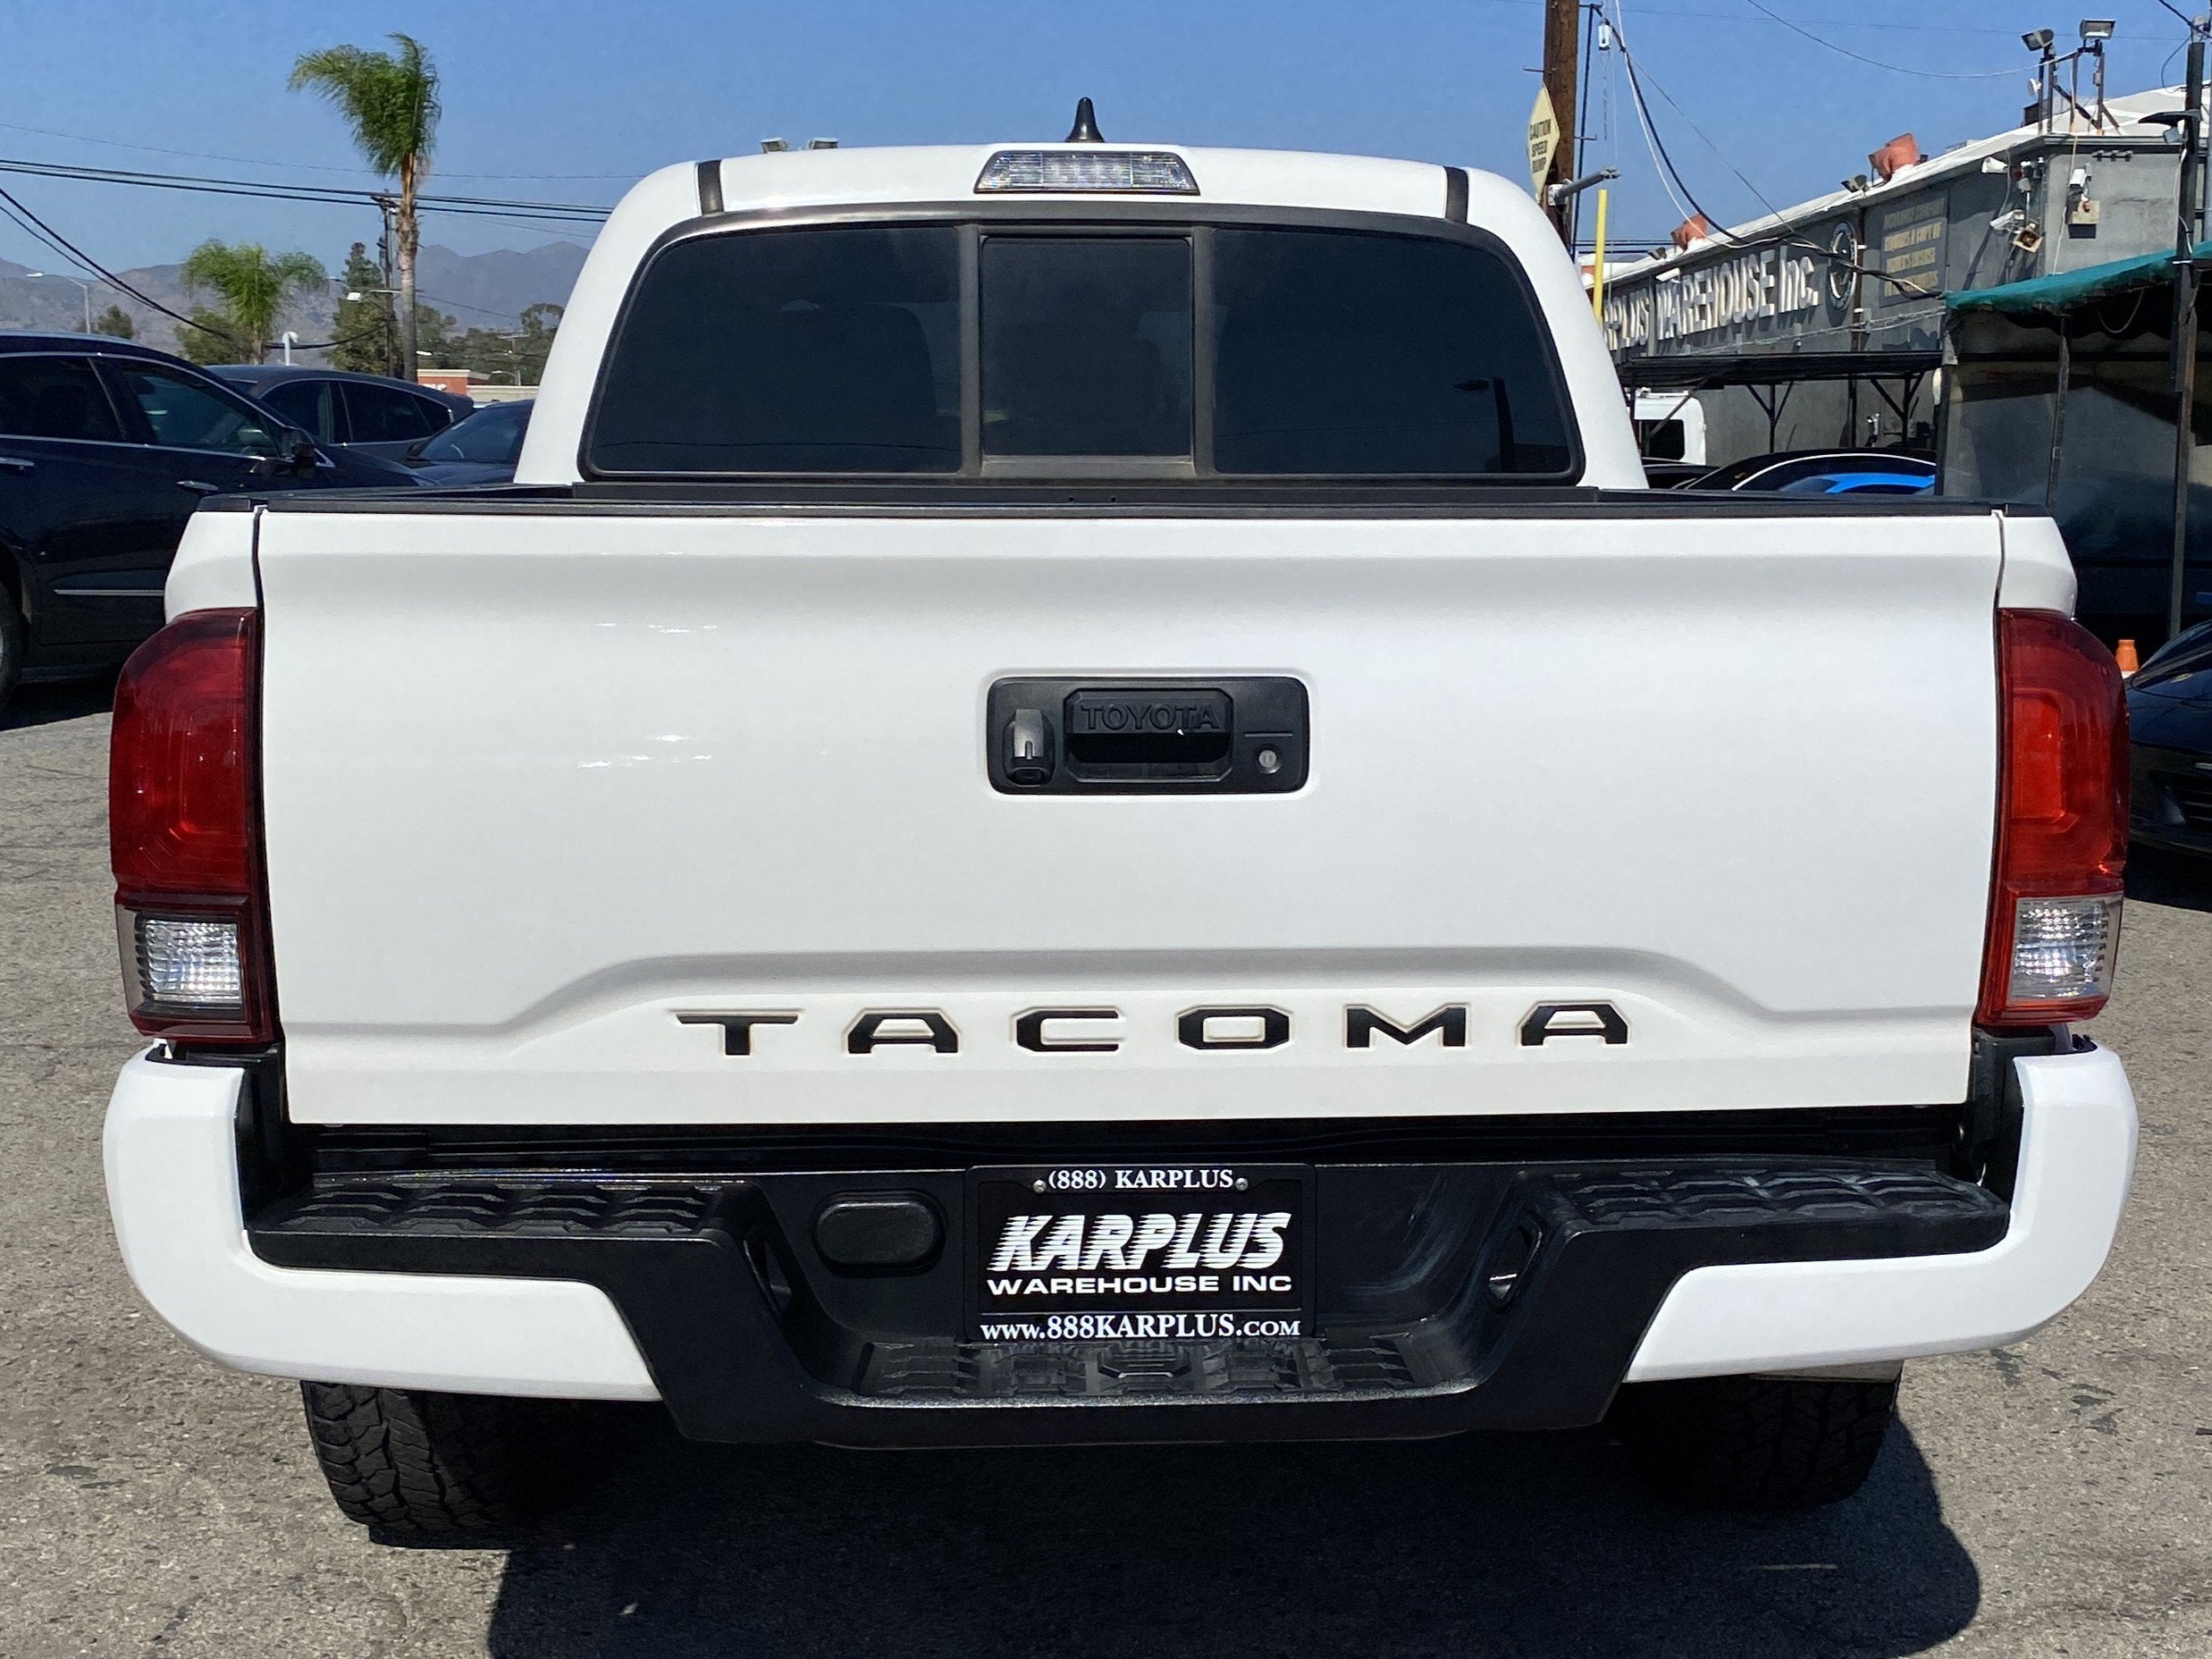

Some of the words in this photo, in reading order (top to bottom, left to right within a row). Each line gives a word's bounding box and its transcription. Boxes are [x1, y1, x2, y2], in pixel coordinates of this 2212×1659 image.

[1529, 118, 1552, 140] CAUTION
[1531, 140, 1548, 157] SPEED
[1656, 248, 1775, 340] WAREHOUSE
[1081, 703, 1221, 730] TOYOTA
[672, 1002, 1630, 1055] TACOMA
[1047, 1169, 1106, 1191] (888)
[1114, 1168, 1233, 1189] KARPLUS
[986, 1212, 1292, 1272] KARPLUS
[987, 1276, 1219, 1296] WAREHOUSE
[1232, 1275, 1292, 1292] INC
